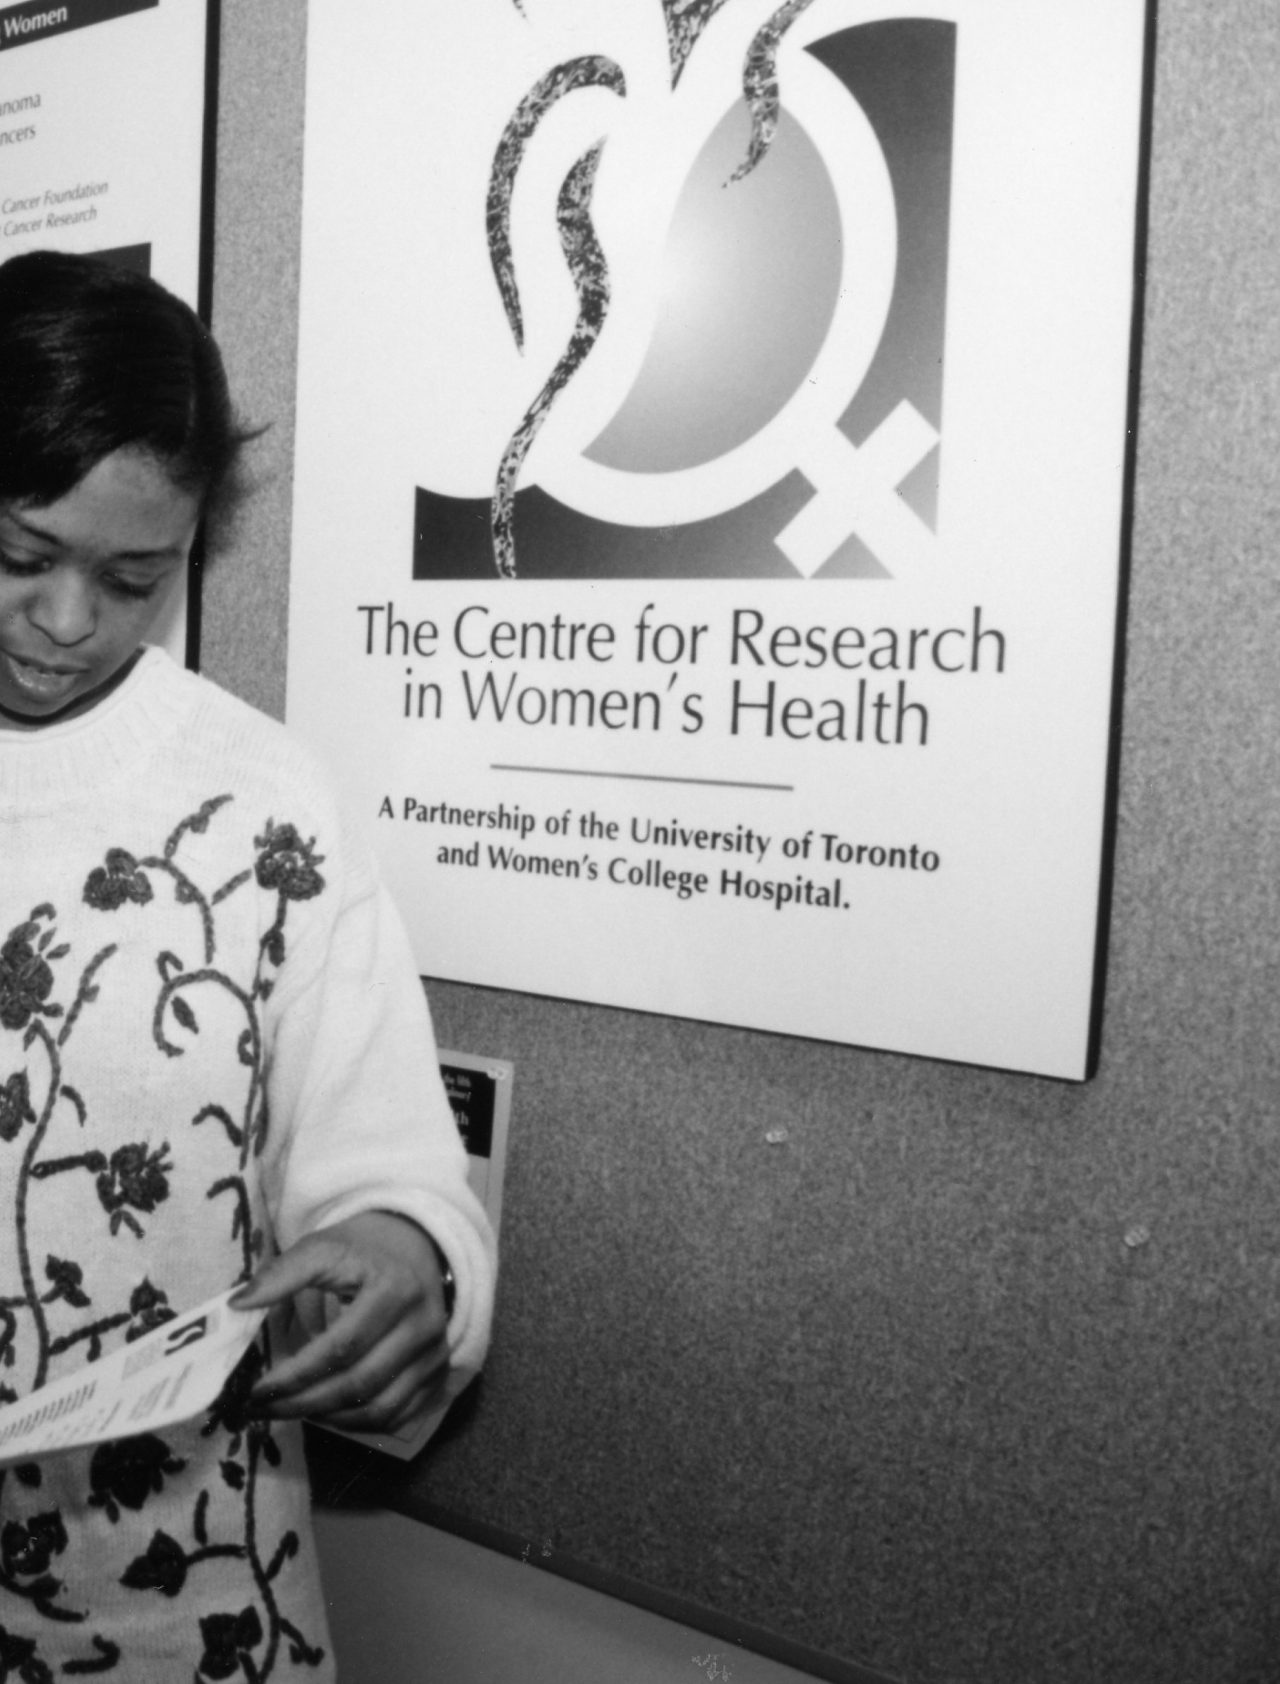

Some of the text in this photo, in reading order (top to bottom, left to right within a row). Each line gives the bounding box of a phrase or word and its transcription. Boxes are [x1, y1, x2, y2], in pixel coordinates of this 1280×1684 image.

[3, 6, 68, 38] Women
[1, 197, 40, 214] Cancer
[43, 182, 109, 206] Foundation
[3, 219, 42, 238] Cancer
[45, 204, 98, 228] Research
[357, 601, 1006, 673] The Centre for Research
[404, 667, 928, 746] in Women's Health
[378, 796, 940, 872] A Partnership of the University of Toronto
[436, 841, 850, 911] and Women's College Hospital.
